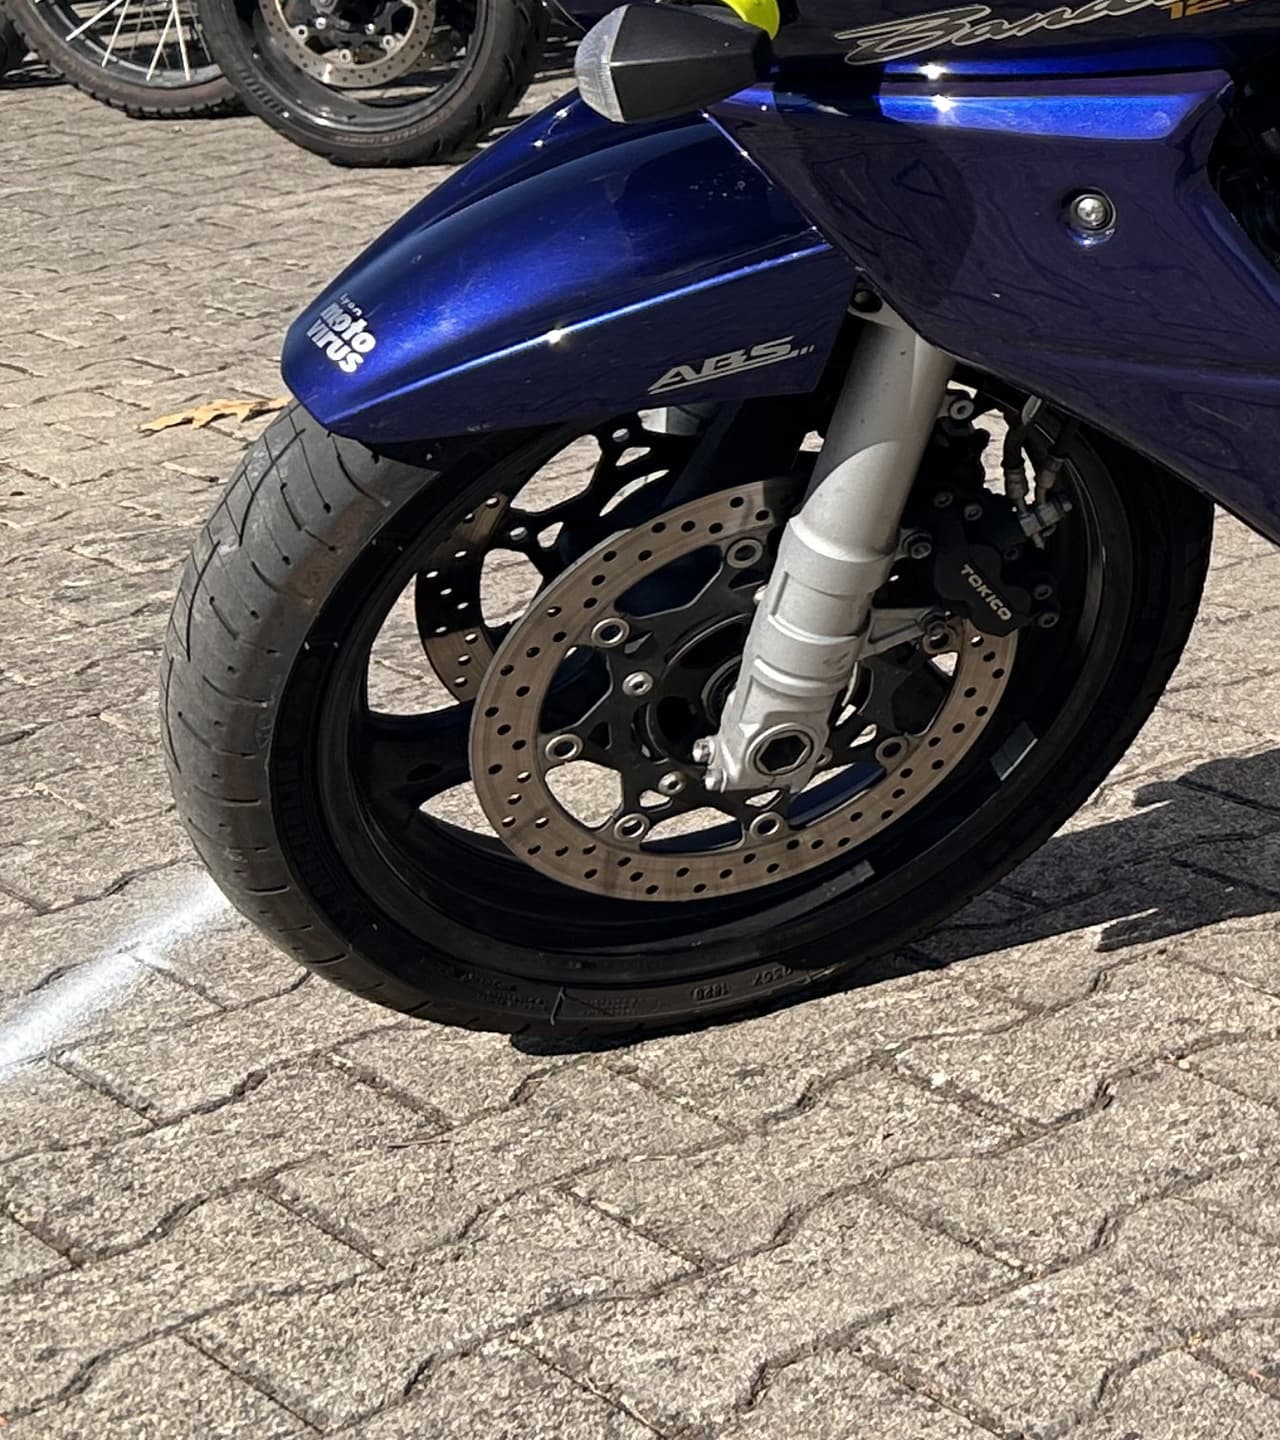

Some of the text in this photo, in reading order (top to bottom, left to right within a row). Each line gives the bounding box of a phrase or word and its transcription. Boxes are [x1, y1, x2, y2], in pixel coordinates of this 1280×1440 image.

[306, 318, 365, 373] virus
[320, 302, 377, 353] moto
[647, 335, 798, 395] ABS
[960, 563, 1013, 621] TOKICO
